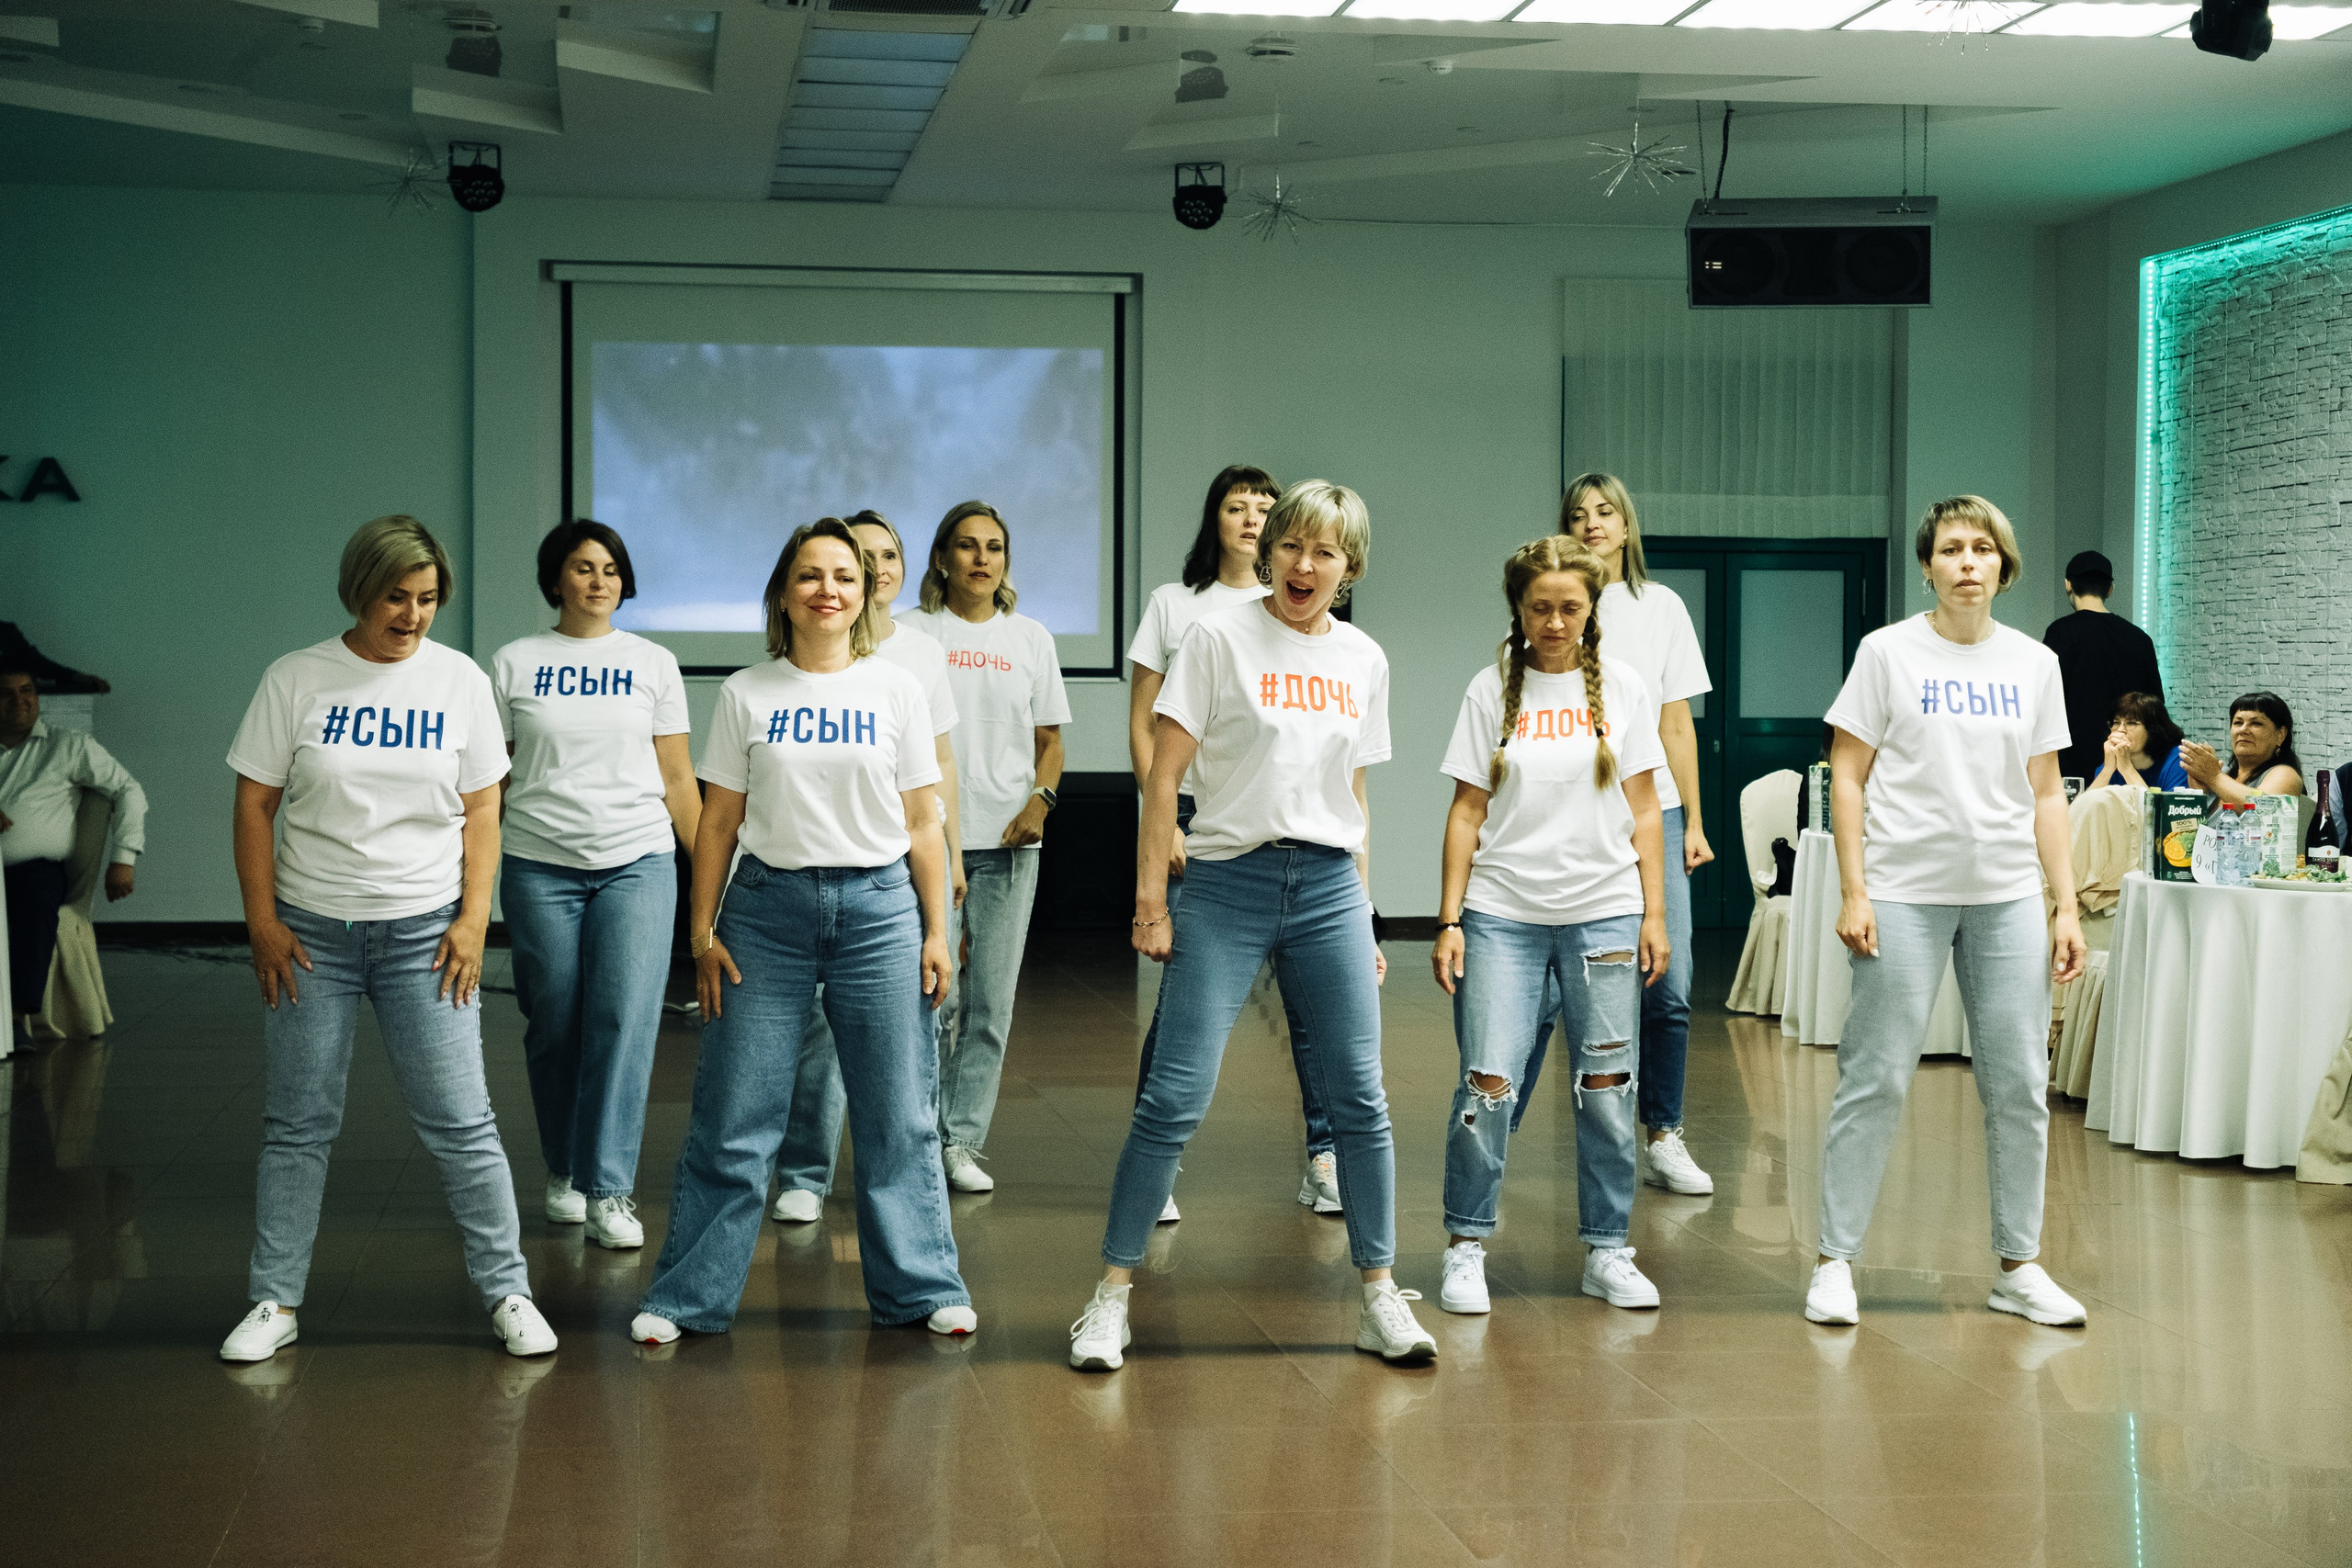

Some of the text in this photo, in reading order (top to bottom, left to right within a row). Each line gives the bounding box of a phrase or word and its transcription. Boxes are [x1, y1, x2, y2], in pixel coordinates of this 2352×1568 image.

[947, 649, 1012, 671] #ДОЧЬ
[533, 665, 633, 696] #СЫН
[1260, 672, 1359, 719] #ДОЧЬ
[1921, 678, 2021, 719] #СЫН
[322, 705, 445, 750] #СЫН
[766, 706, 876, 746] #СЫН
[2167, 805, 2202, 816] Добрый
